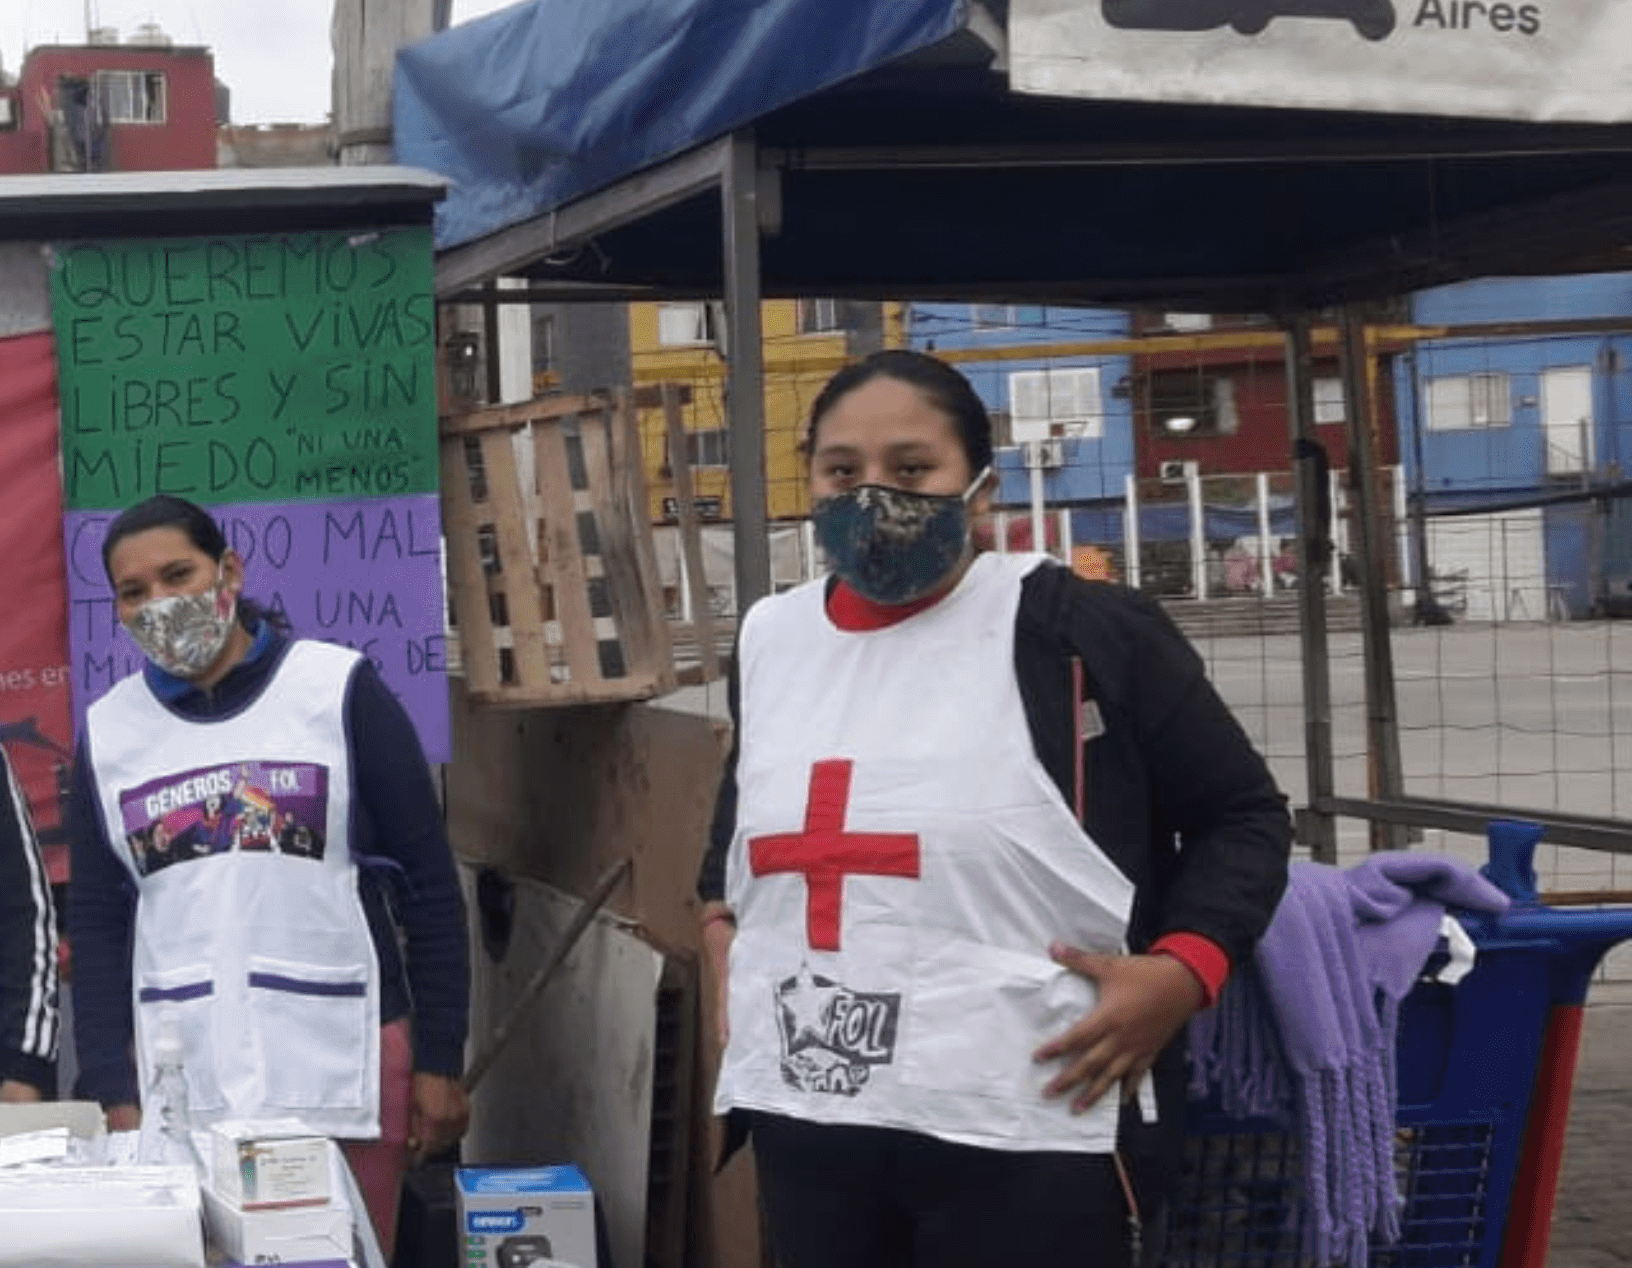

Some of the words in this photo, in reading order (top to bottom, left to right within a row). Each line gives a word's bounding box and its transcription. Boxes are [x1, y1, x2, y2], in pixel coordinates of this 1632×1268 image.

[1414, 0, 1540, 35] Aires
[64, 237, 396, 307] QUEREMOS
[72, 311, 245, 366] ESTAR
[269, 371, 297, 420] Y
[342, 427, 404, 452] UNA
[316, 589, 403, 629] UNA
[827, 992, 889, 1057] FOL
